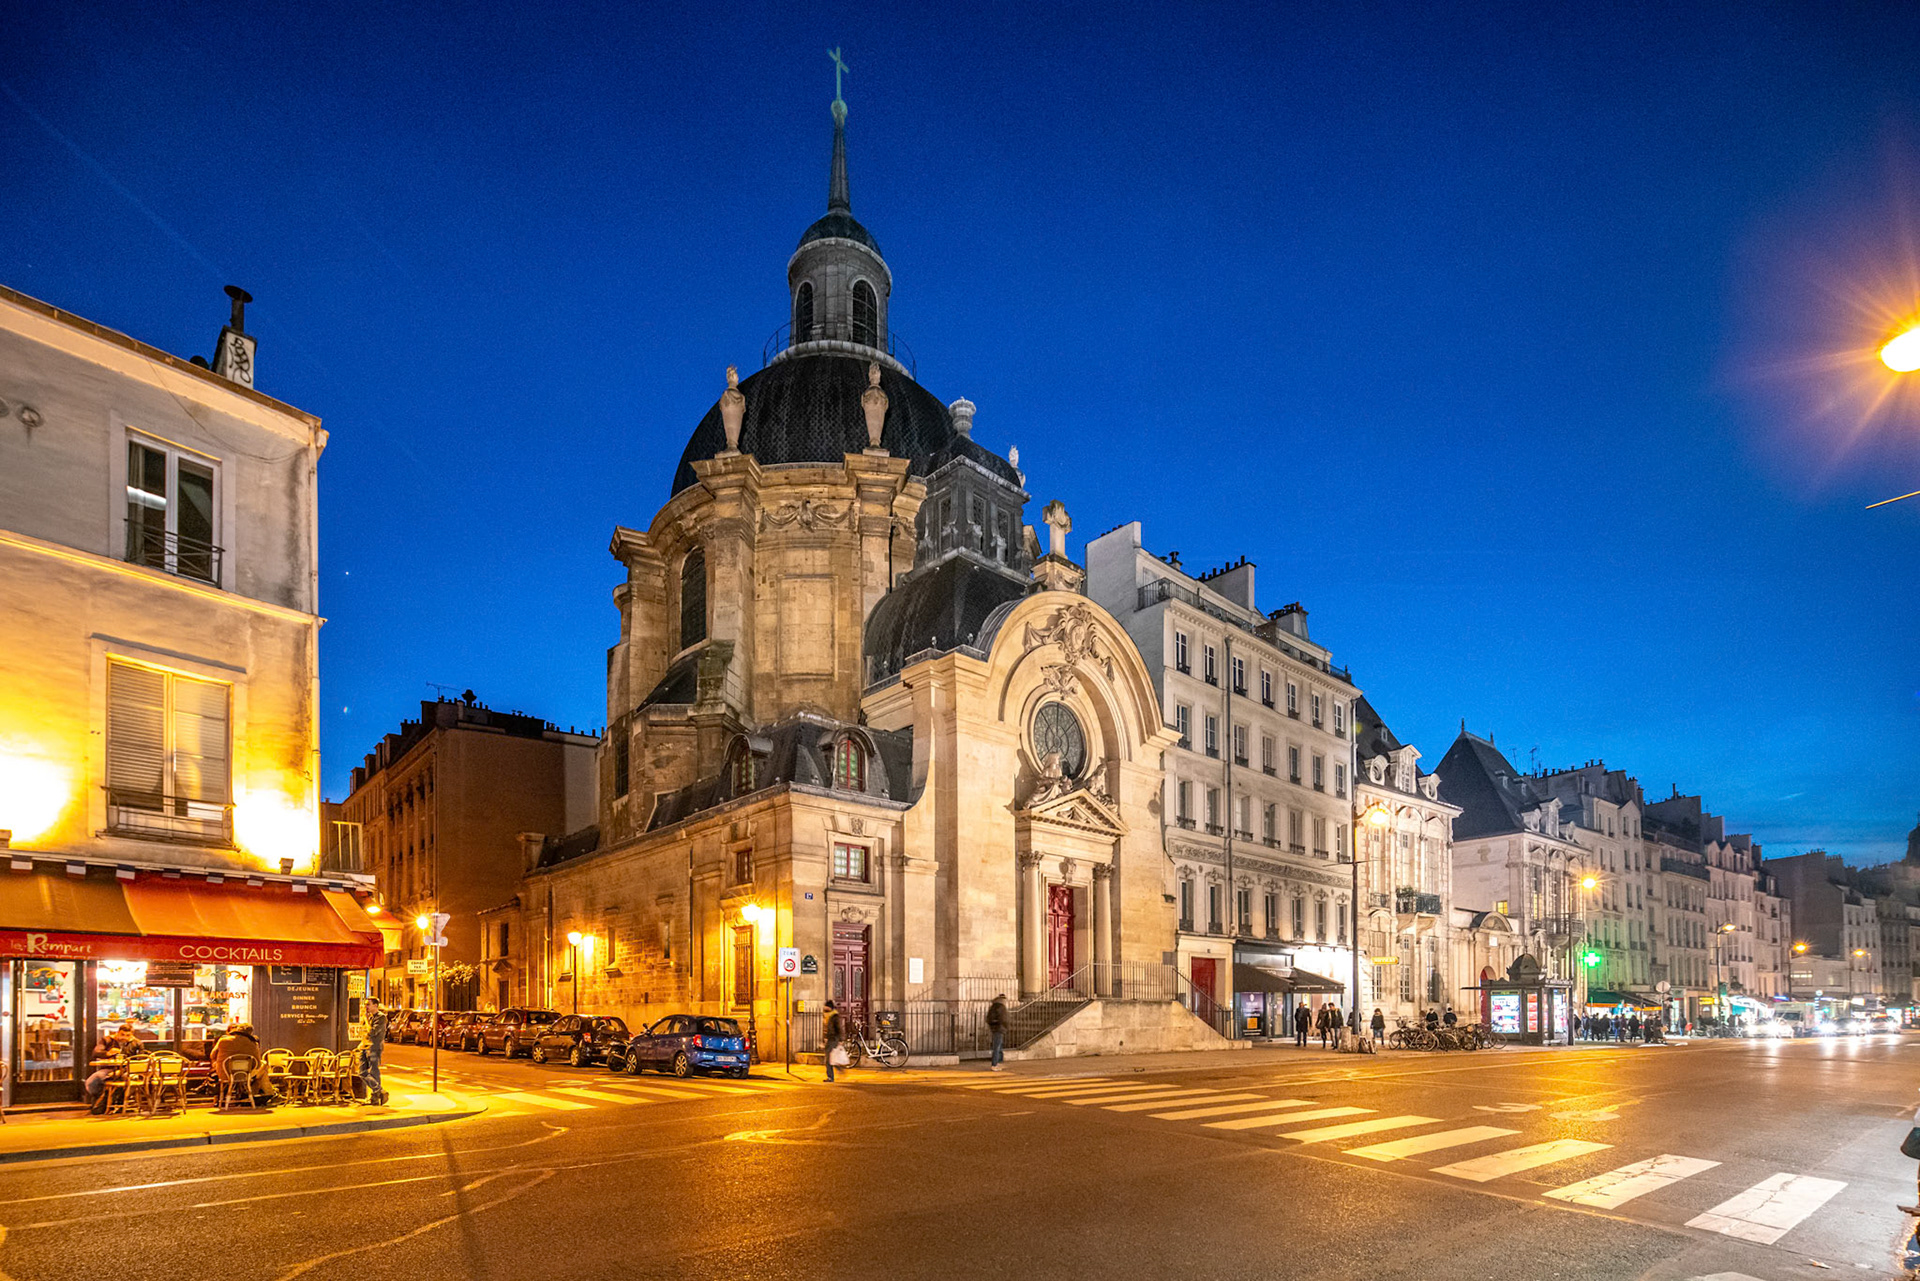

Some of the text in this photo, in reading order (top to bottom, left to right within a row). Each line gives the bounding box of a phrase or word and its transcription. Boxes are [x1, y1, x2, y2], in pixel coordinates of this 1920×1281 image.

[27, 933, 91, 954] Rempart
[179, 945, 282, 961] COCKTAILS
[189, 991, 247, 999] BREAKFAST
